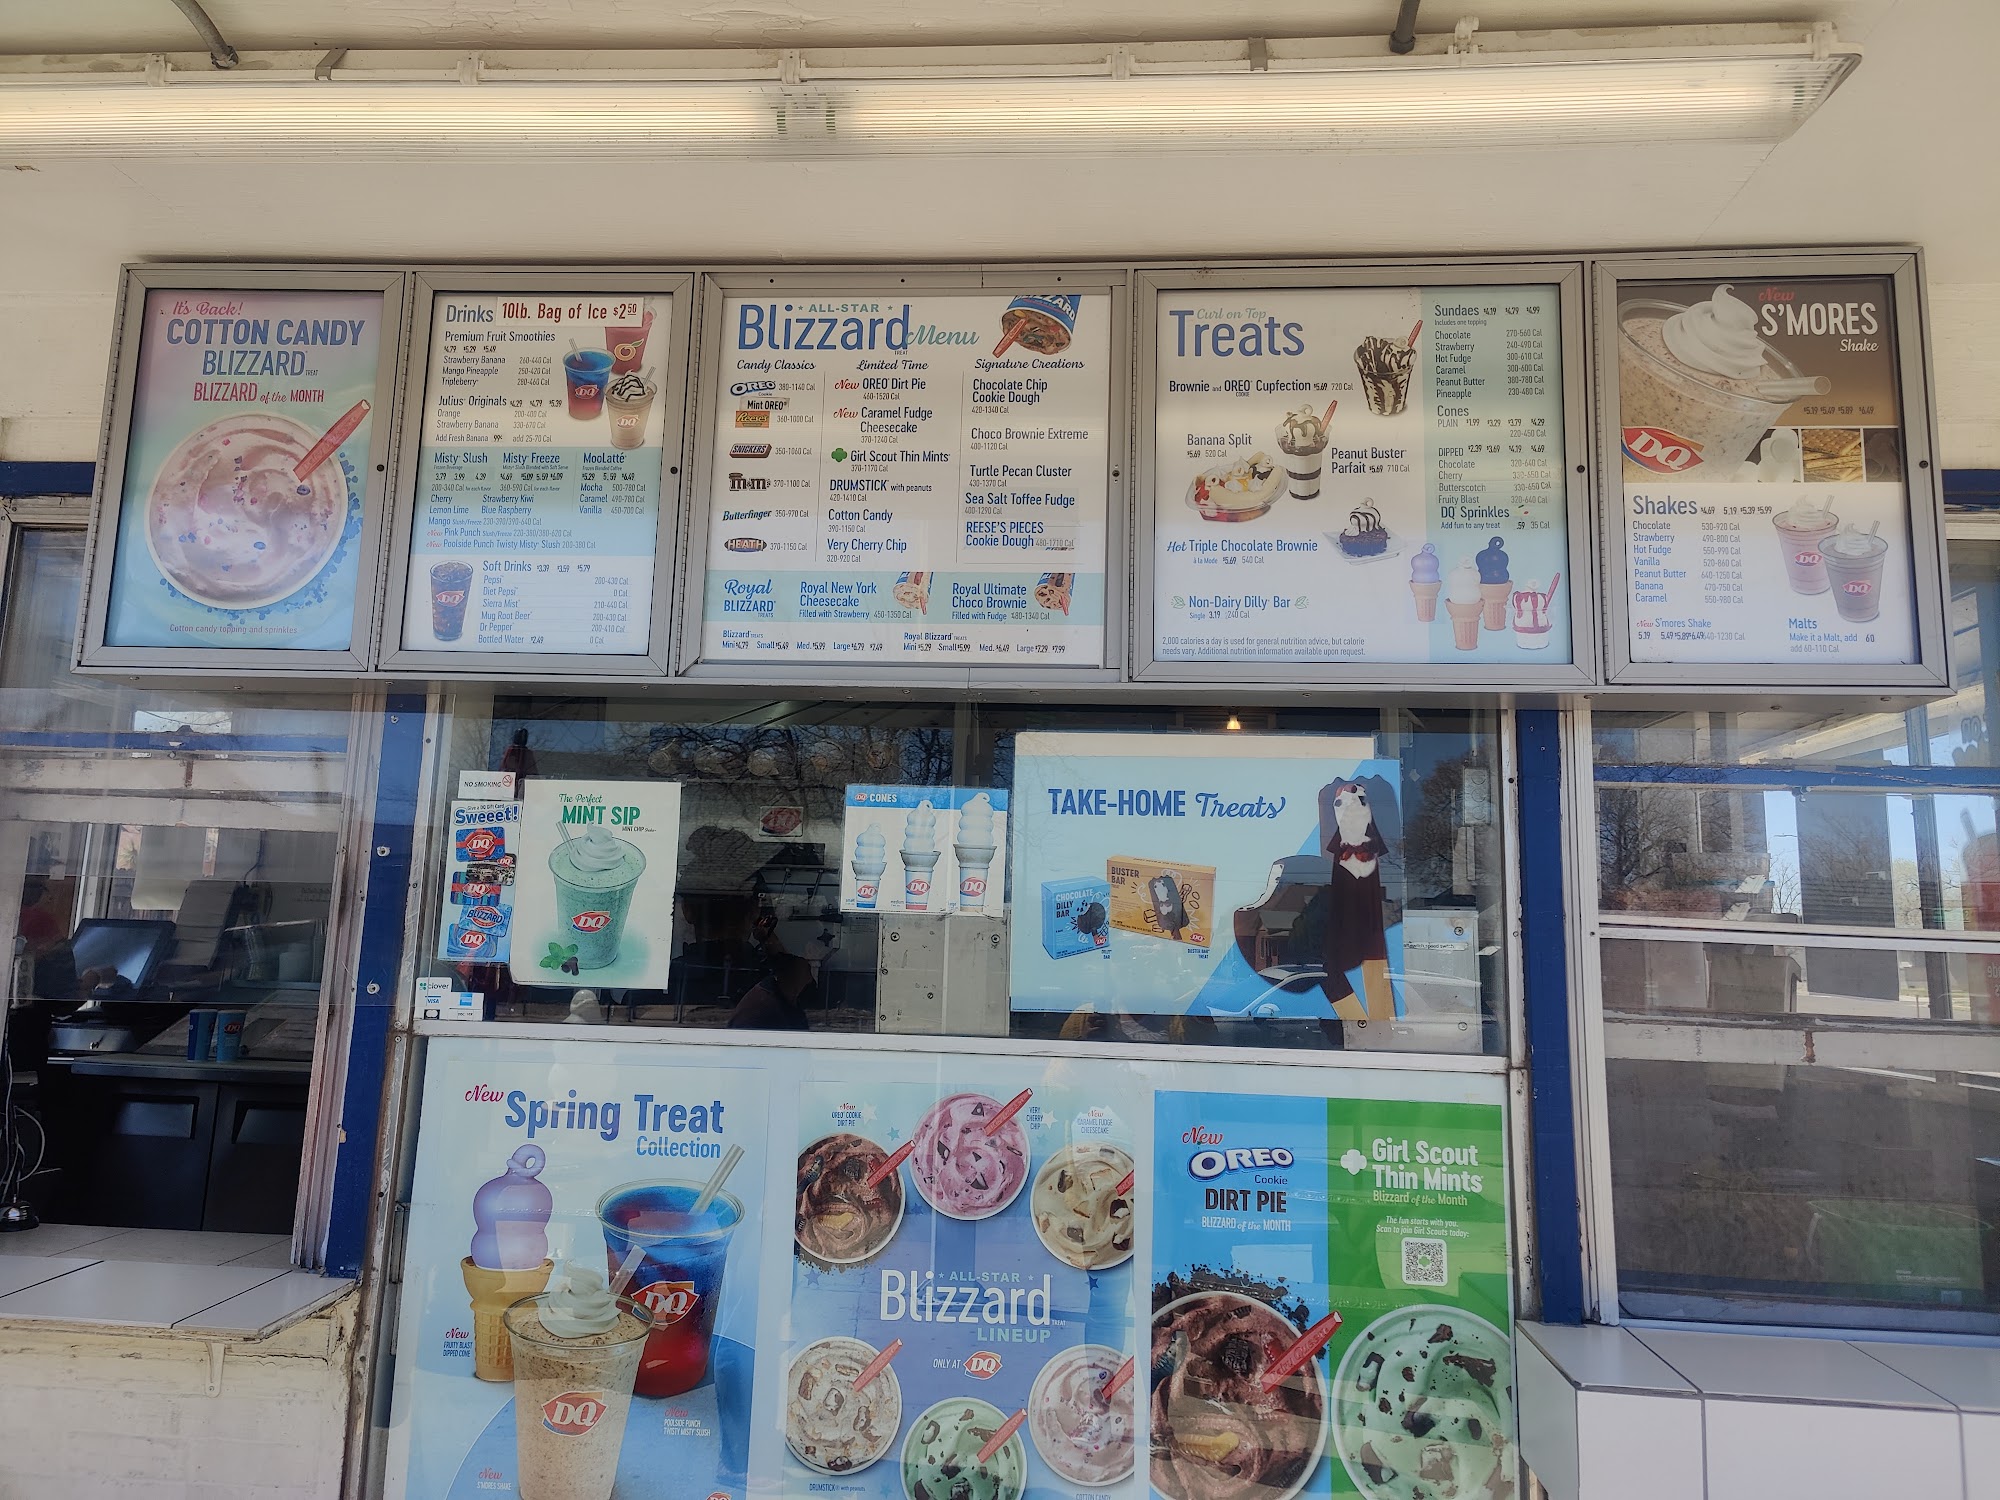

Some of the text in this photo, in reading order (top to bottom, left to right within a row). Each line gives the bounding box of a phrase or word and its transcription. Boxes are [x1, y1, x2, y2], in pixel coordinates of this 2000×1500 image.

[1759, 287, 1794, 301] New
[173, 301, 243, 316] It's Back!
[446, 305, 494, 323] Drinks
[503, 302, 531, 319] 10lb.
[538, 303, 561, 323] Bag
[569, 304, 581, 319] of
[588, 304, 607, 319] Ice
[809, 304, 879, 313] ALL-STAR
[1434, 305, 1479, 316] Sundaes
[167, 319, 365, 346] COTTON CANDY
[738, 304, 910, 350] Blizzard
[1169, 310, 1305, 357] Treats
[445, 332, 555, 342] Premium Fruit Smoothies
[906, 325, 980, 345] Menu
[1840, 339, 1878, 352] Shake
[203, 351, 308, 376] BLIZZARD
[737, 360, 816, 373] Candy Classics
[856, 360, 930, 371] Limited Time
[975, 359, 1085, 372] Signature Creations
[730, 381, 776, 396] OREO
[973, 379, 1047, 392] Chocolate Chip
[973, 392, 1040, 405] Cookie Dough
[833, 407, 932, 421] New Caramel Fudge
[1437, 405, 1469, 416] Cones
[861, 422, 917, 433] Cheesecake
[971, 428, 1088, 440] Choco Brownie Extreme
[1187, 434, 1252, 448] Banana Split
[732, 445, 765, 454] SNICKERS
[851, 450, 948, 462] Girl Scout Thin Mints
[1332, 448, 1405, 459] Peanut Buster
[1629, 431, 1692, 470] DQ
[434, 452, 488, 464] Misty Slush
[970, 465, 1072, 477] Turtle Pecan Cluster
[965, 493, 1075, 508] Sea Salt Toffee Fudge
[1633, 495, 1697, 515] Shakes
[429, 506, 469, 514] Lemon Lime
[829, 509, 892, 523] Cotton Candy
[1441, 506, 1510, 520] DQ Sprinkles
[728, 539, 764, 549] HEATH
[827, 539, 907, 553] Very Cherry Chip
[1167, 540, 1318, 554] Hot Triple Chocolate Brownie
[483, 561, 531, 572] Soft Drinks
[724, 579, 773, 599] Royal
[800, 582, 877, 595] Royal New York
[952, 583, 1027, 597] Royal Ultimate
[724, 601, 774, 612] BLIZZARD
[800, 595, 859, 606] Cheesecake
[952, 597, 1027, 608] Choco Brownie
[1189, 596, 1290, 610] Non-Dairy Dilly Bar
[799, 610, 869, 619] Filled with Strawberry
[170, 624, 193, 632] Cotton
[196, 625, 217, 633] candy
[220, 625, 246, 634] topping
[265, 626, 297, 634] sprinkles
[1789, 618, 1817, 629] Malts
[1162, 638, 1179, 646] 2,000
[1180, 638, 1204, 646] calories
[1211, 638, 1222, 647] day
[1230, 638, 1244, 646] used
[1256, 638, 1279, 648] general
[1281, 638, 1307, 646] nutrition
[1309, 638, 1330, 647] advice,
[1332, 638, 1342, 646] but
[1343, 638, 1364, 646] calorie
[1047, 788, 1286, 820] TAKE-HOME Treats
[455, 806, 518, 823] Sweeet!
[562, 806, 641, 825] MINT SIP
[1112, 867, 1139, 878] BUSTER
[1112, 876, 1125, 885] BAR
[1055, 889, 1093, 901] CHOCOLATE
[1056, 901, 1074, 910] DILLY
[1056, 909, 1069, 918] BAR
[579, 914, 606, 928] DQ
[505, 1089, 725, 1141] Spring Treat
[637, 1136, 720, 1158] Collection
[1372, 1137, 1478, 1166] Girl Scout
[1189, 1148, 1293, 1180] OREO
[1372, 1164, 1482, 1192] Thin Mints
[1205, 1188, 1287, 1212] DIRT PIE
[1430, 1218, 1443, 1226] with
[949, 1271, 1020, 1283] ALL-STAR
[879, 1270, 1051, 1325] Blizzard
[977, 1328, 1051, 1343] LINEUP
[553, 1402, 598, 1426] DQ
